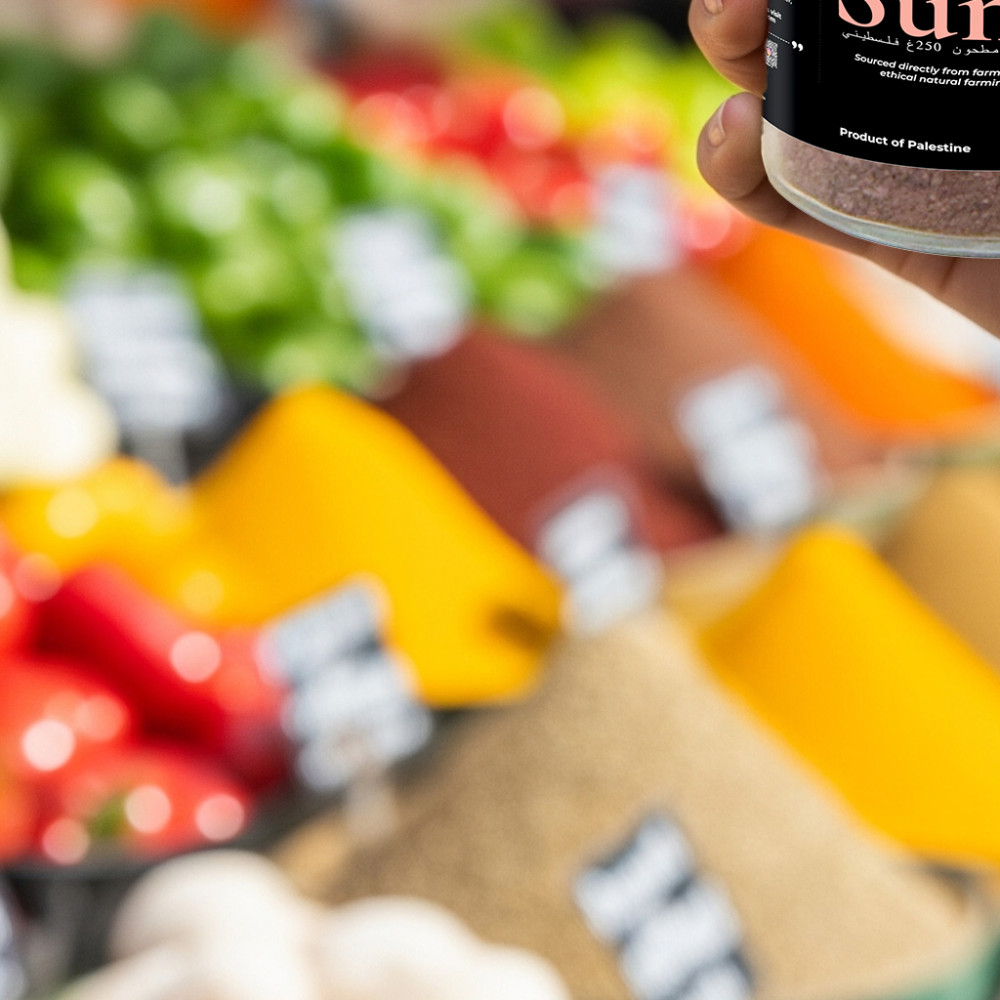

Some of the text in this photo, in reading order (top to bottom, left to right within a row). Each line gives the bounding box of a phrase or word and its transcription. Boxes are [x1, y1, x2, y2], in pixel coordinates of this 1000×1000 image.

[854, 53, 897, 69] Sourced
[898, 62, 940, 75] directly
[942, 67, 970, 76] from
[880, 70, 917, 82] ethical
[919, 76, 961, 86] natural
[840, 127, 971, 153] Product of Palestine
